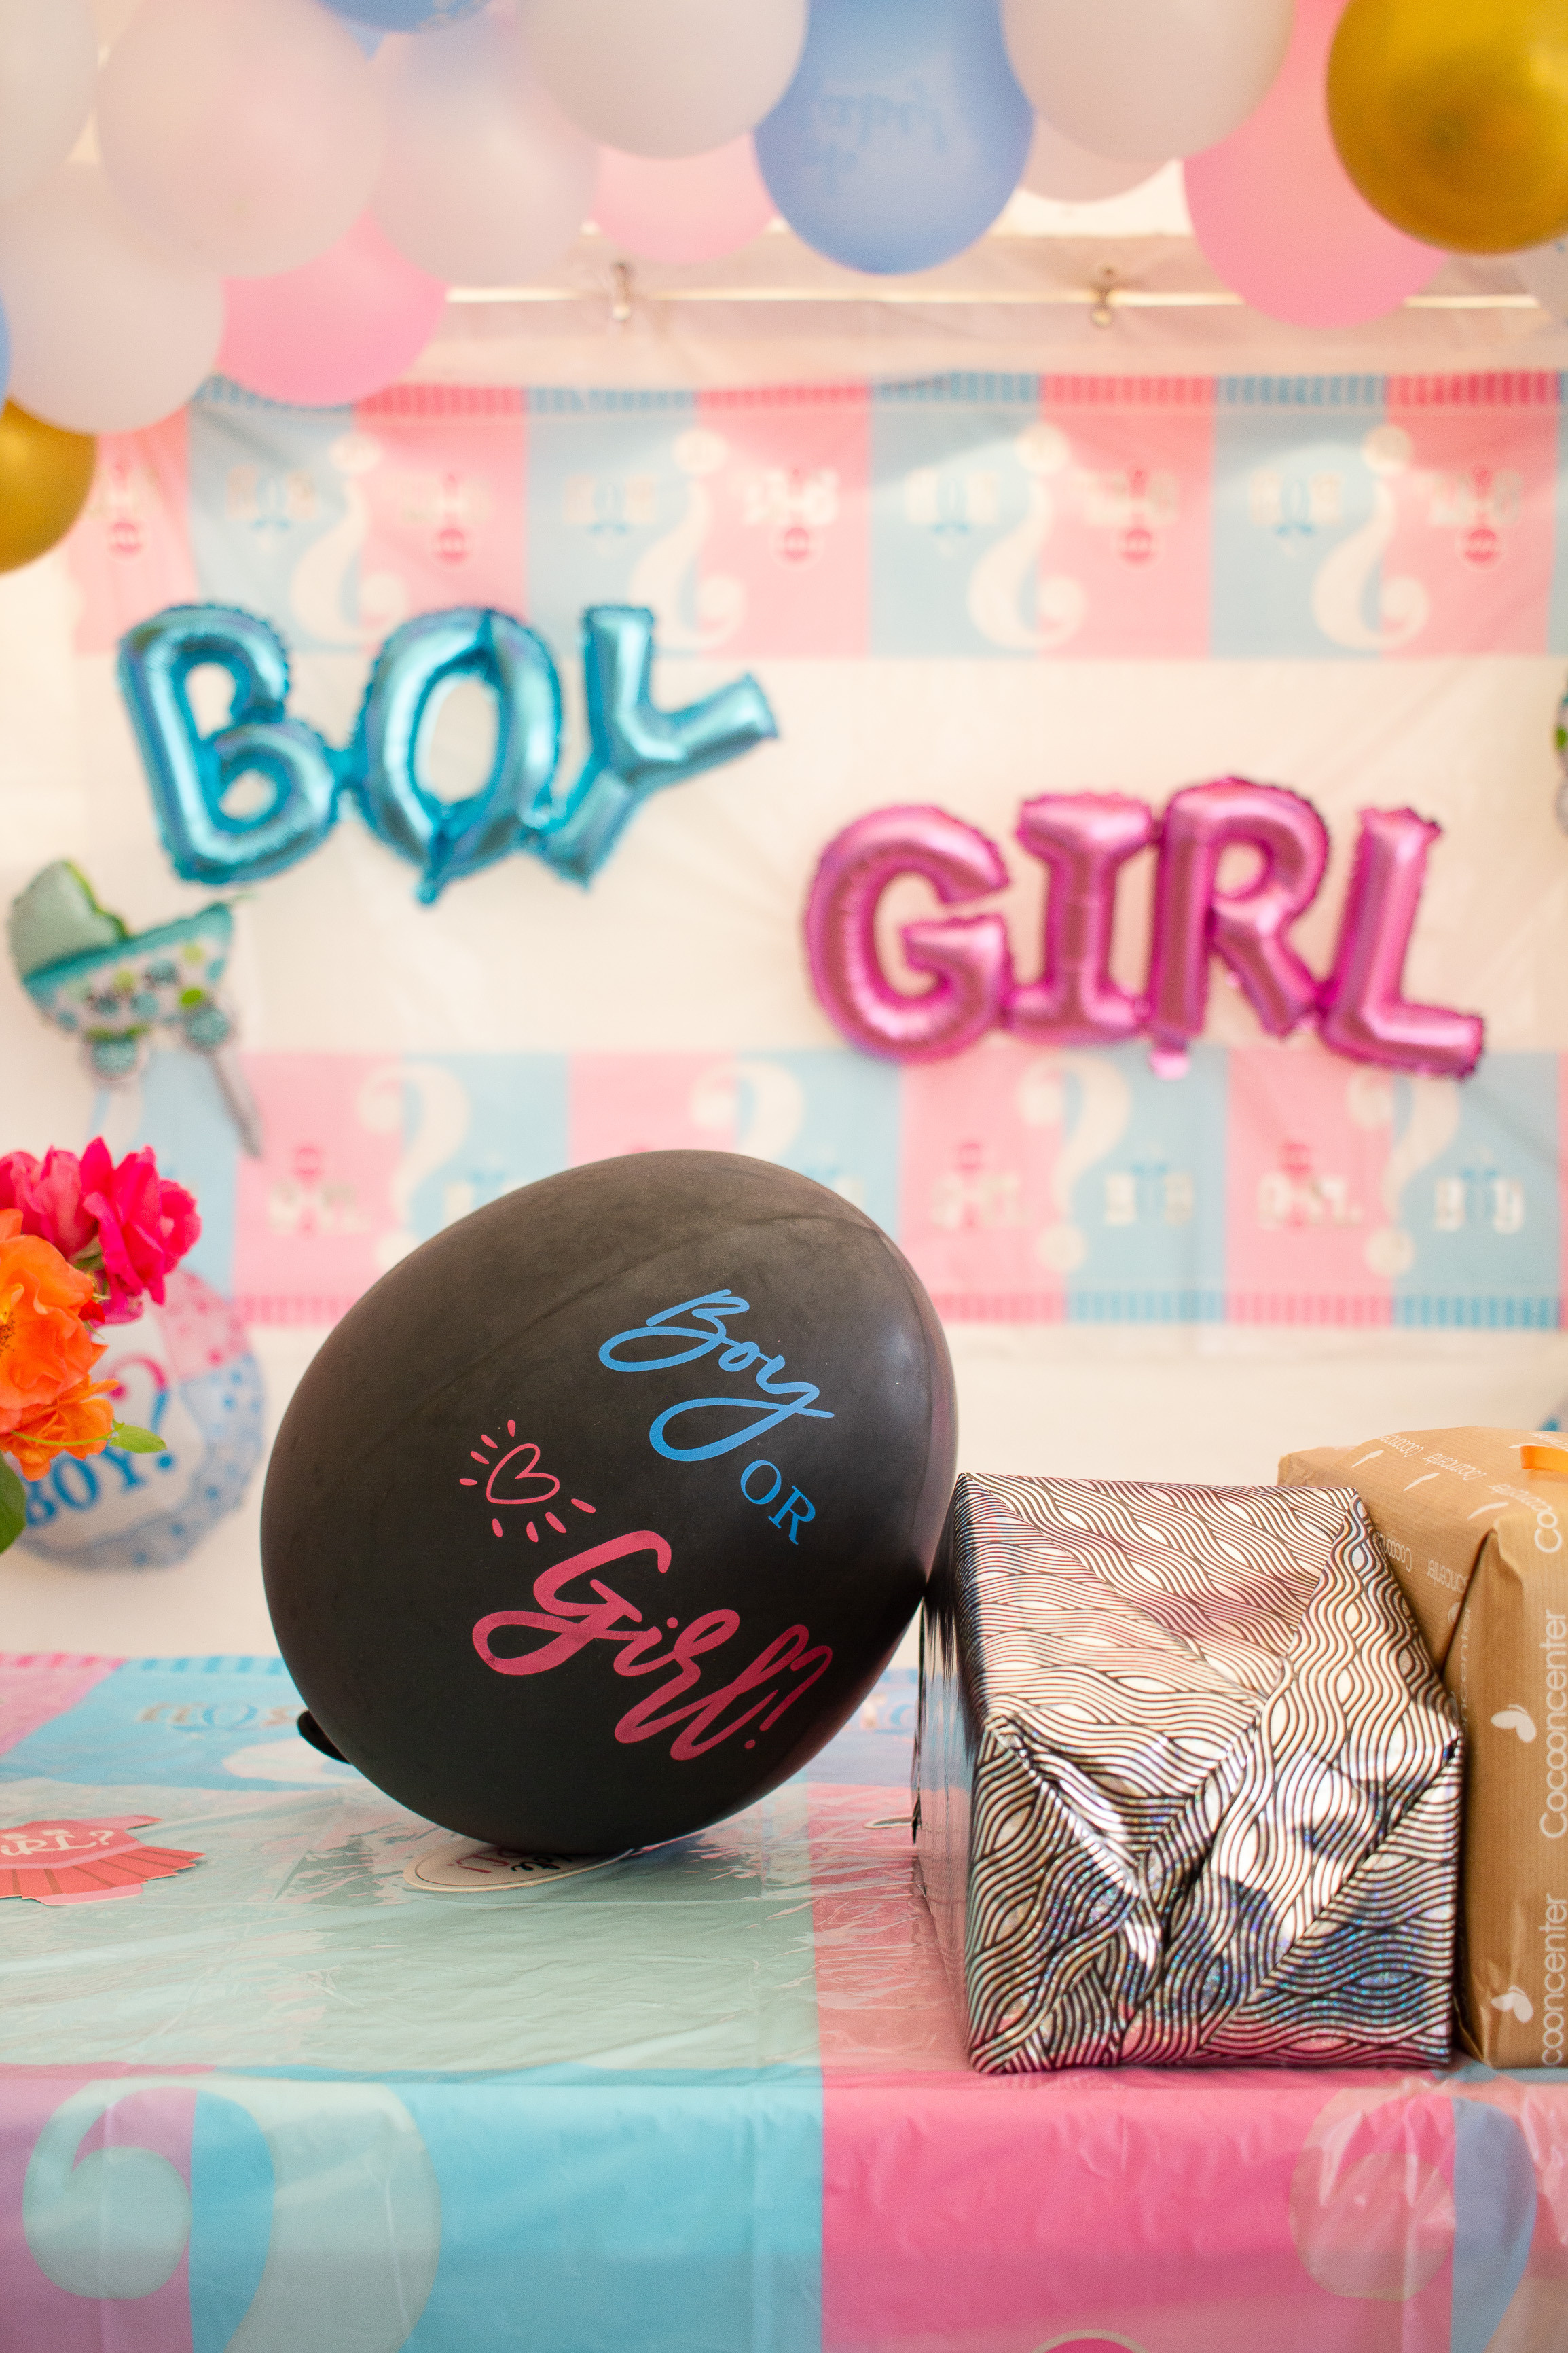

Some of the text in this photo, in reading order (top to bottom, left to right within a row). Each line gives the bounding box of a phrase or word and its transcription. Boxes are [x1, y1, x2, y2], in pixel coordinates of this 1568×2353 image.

[117, 603, 780, 902] BOY
[805, 776, 1484, 1079] GIRL
[598, 1289, 835, 1462] Boy
[740, 1460, 816, 1545] OR
[1539, 1608, 1568, 1839] Cocooncenter
